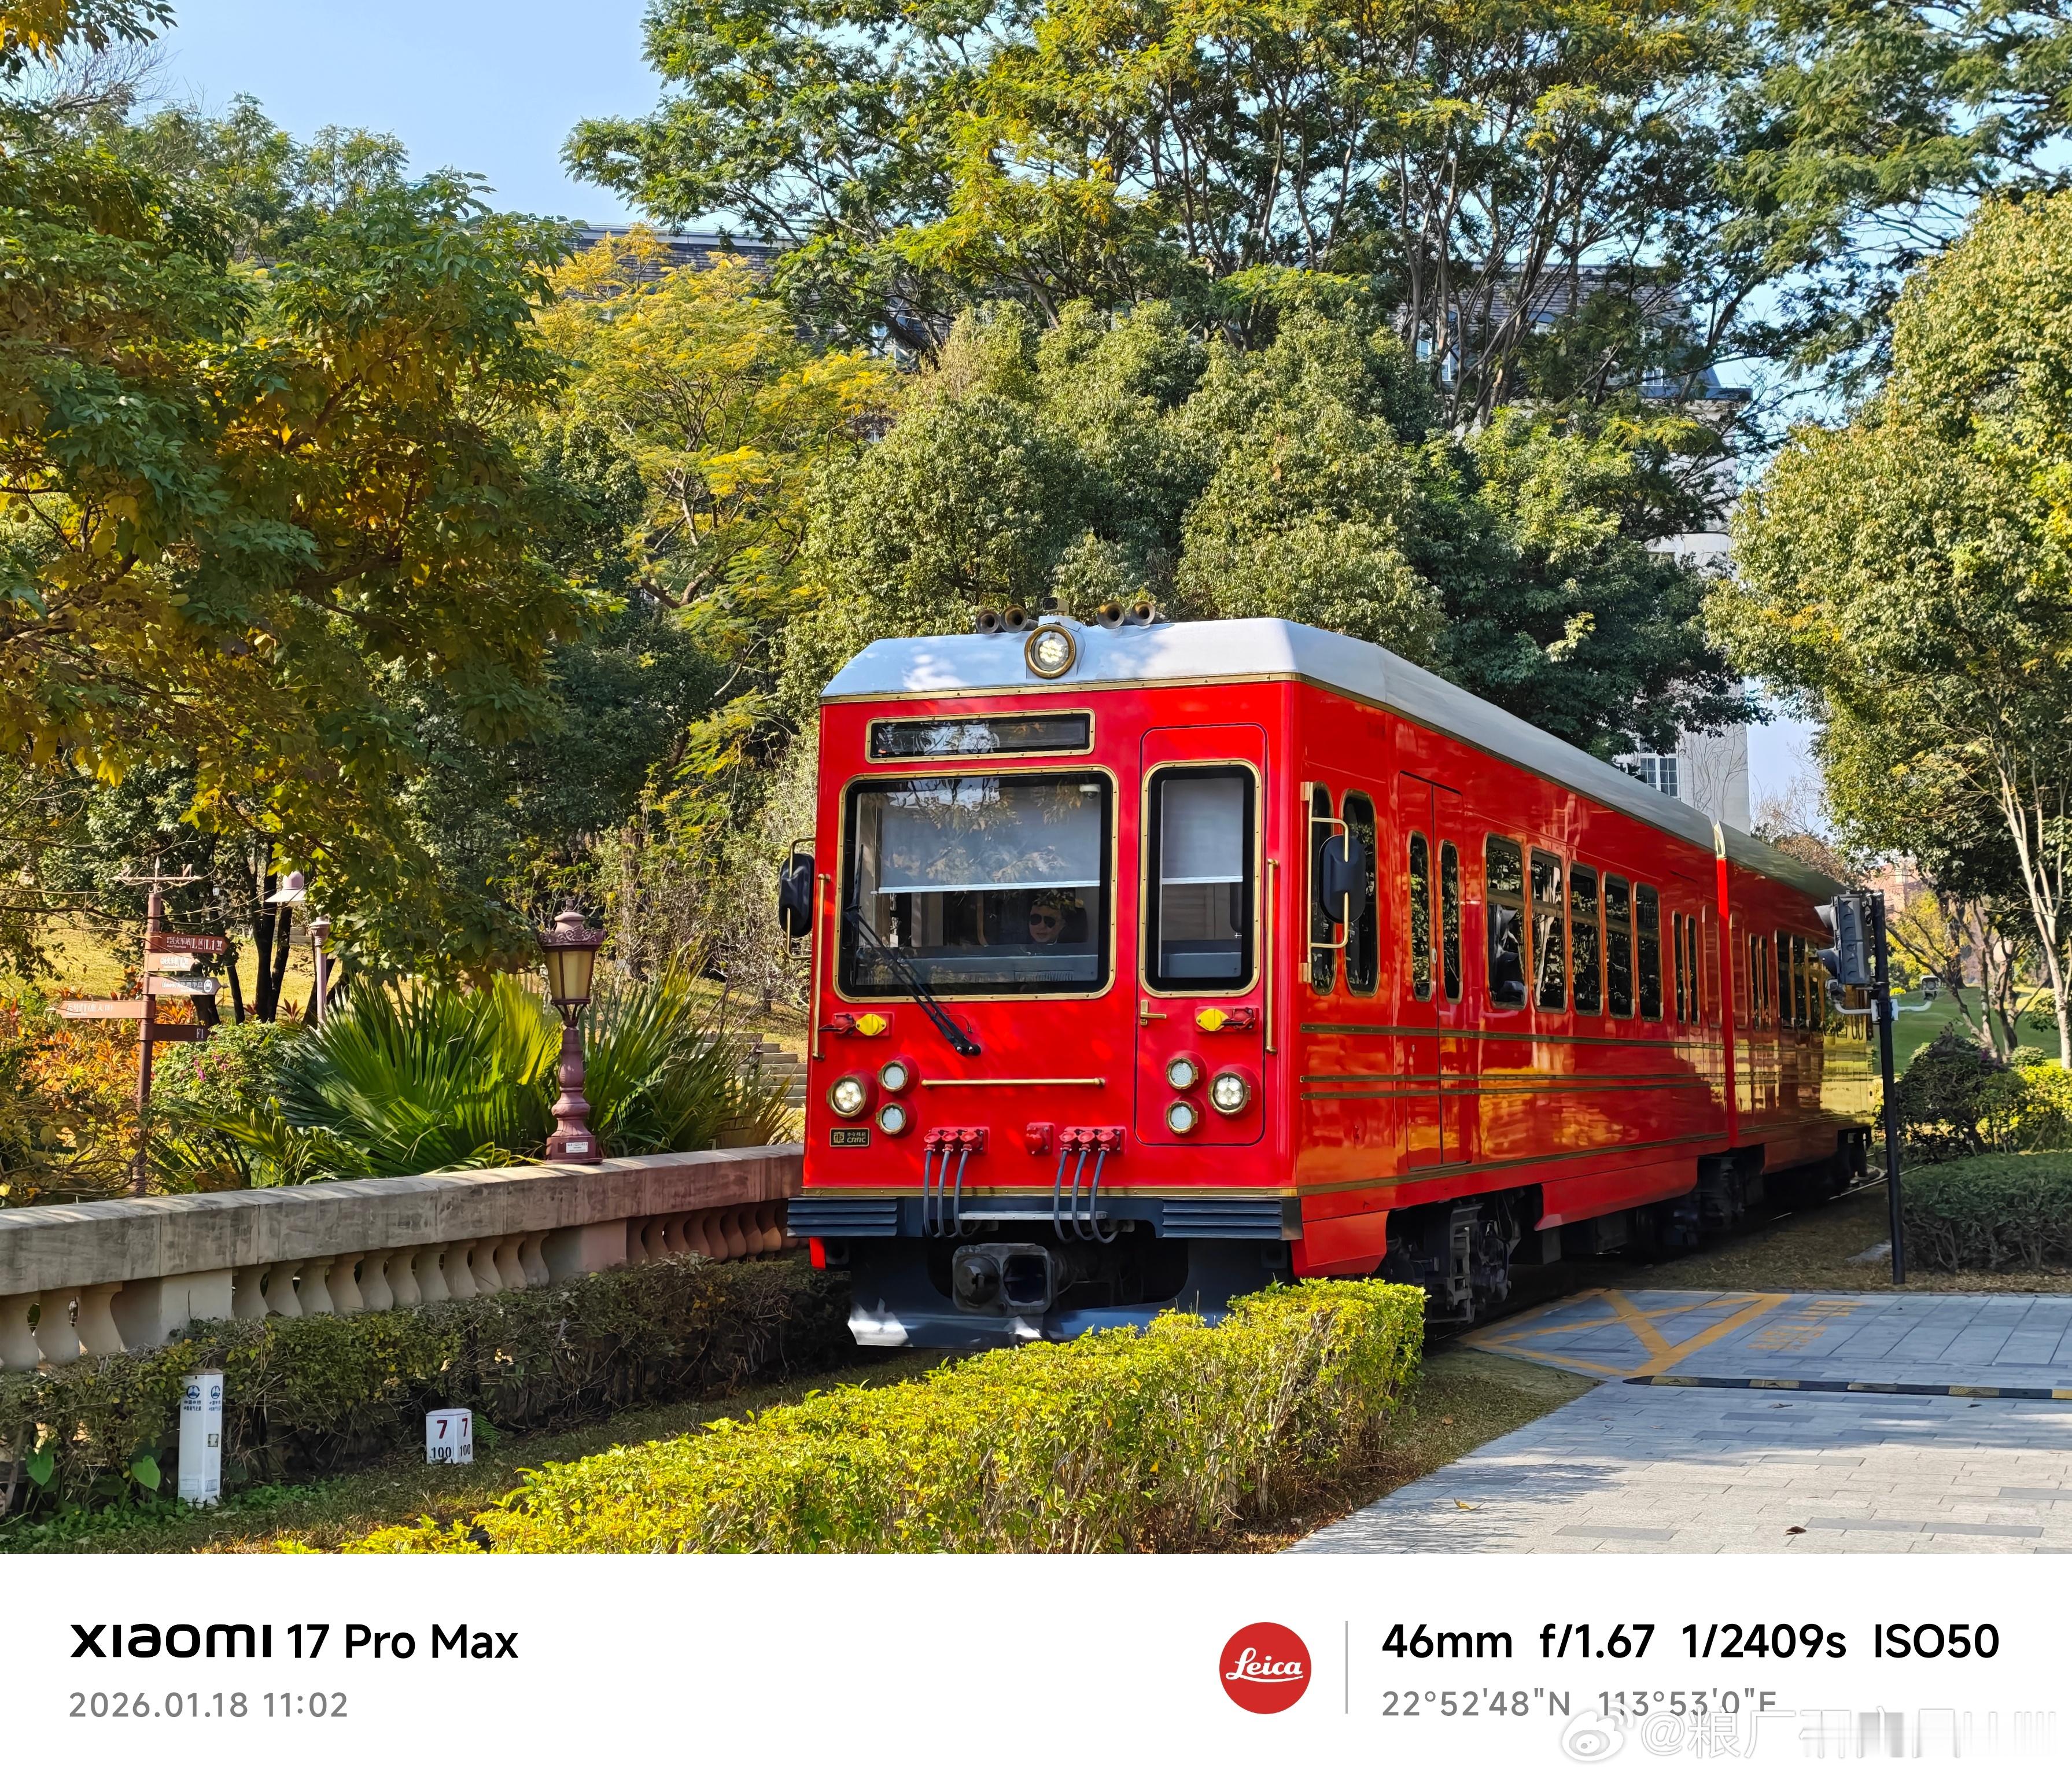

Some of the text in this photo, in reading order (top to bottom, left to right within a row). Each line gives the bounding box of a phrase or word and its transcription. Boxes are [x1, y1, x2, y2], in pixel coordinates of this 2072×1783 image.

[437, 1420, 448, 1439] 7
[462, 1417, 468, 1437] 7
[431, 1446, 452, 1458] 100
[459, 1443, 471, 1457] 100
